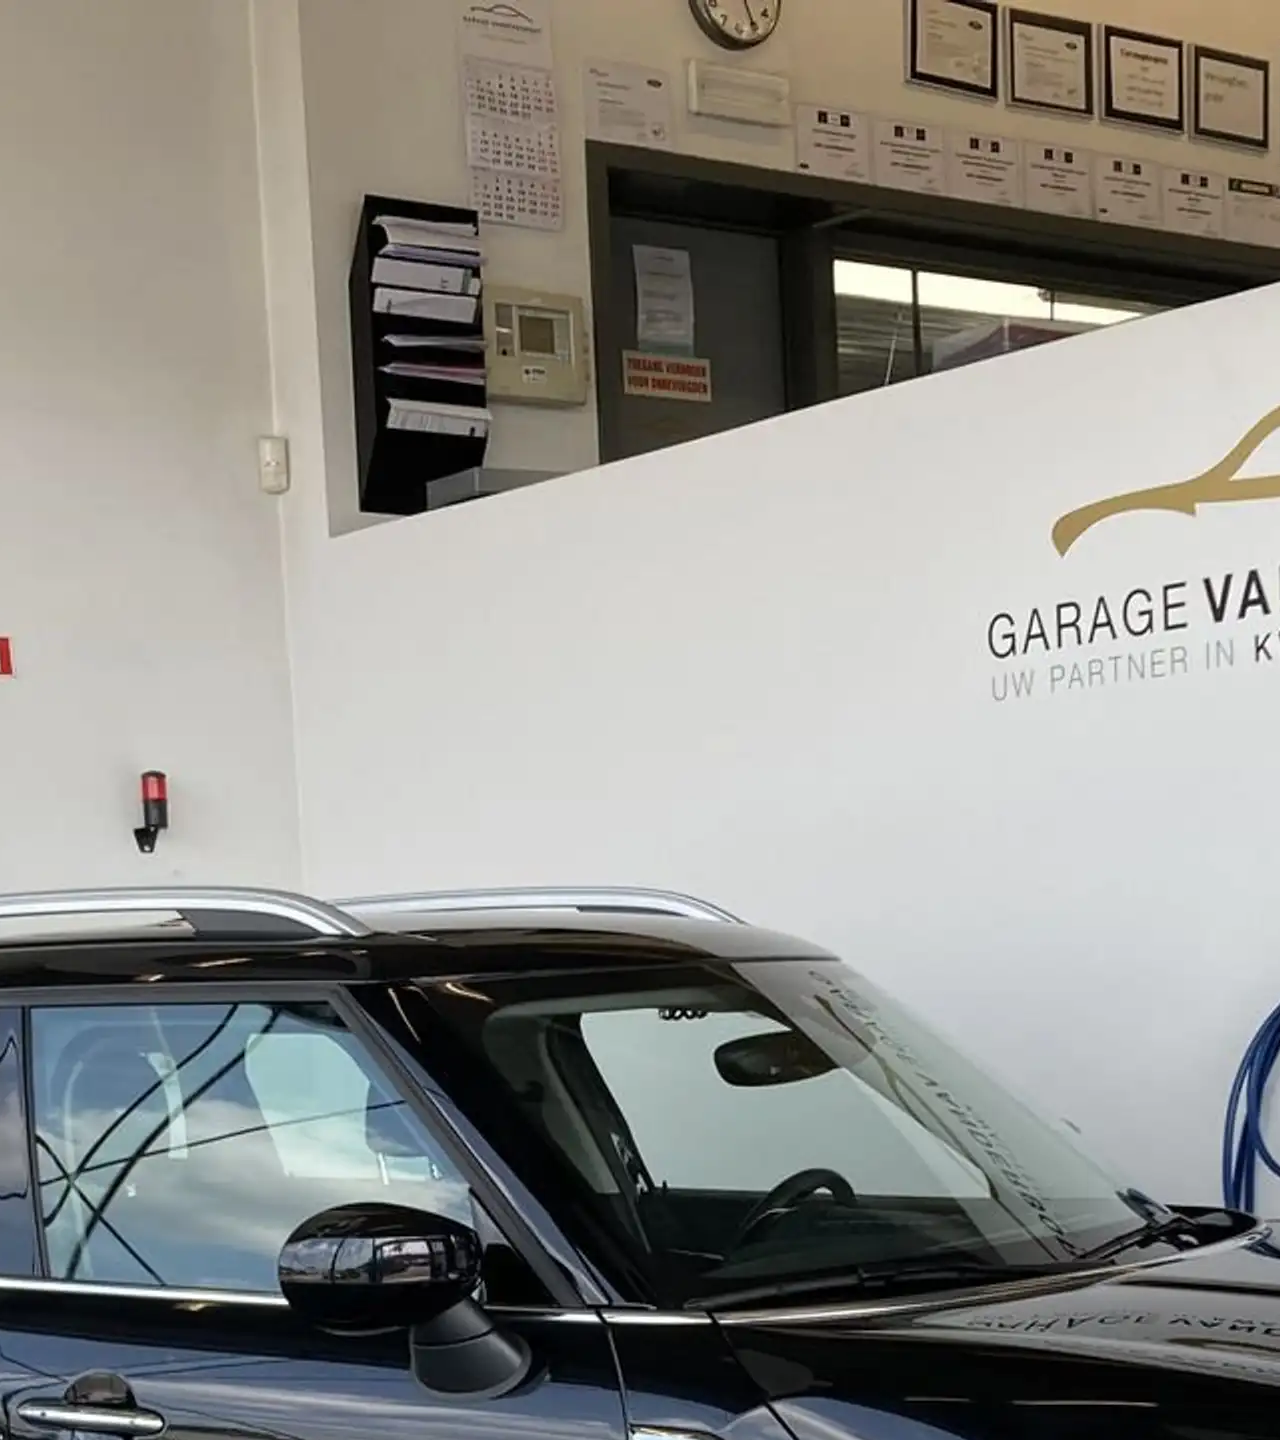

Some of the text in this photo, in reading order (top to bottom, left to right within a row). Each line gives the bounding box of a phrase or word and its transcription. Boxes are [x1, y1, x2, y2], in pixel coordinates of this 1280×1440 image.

[987, 581, 1188, 659] GARAGE
[992, 668, 1036, 702] UW
[1050, 645, 1188, 693] PARTNER
[1206, 638, 1235, 671] IN
